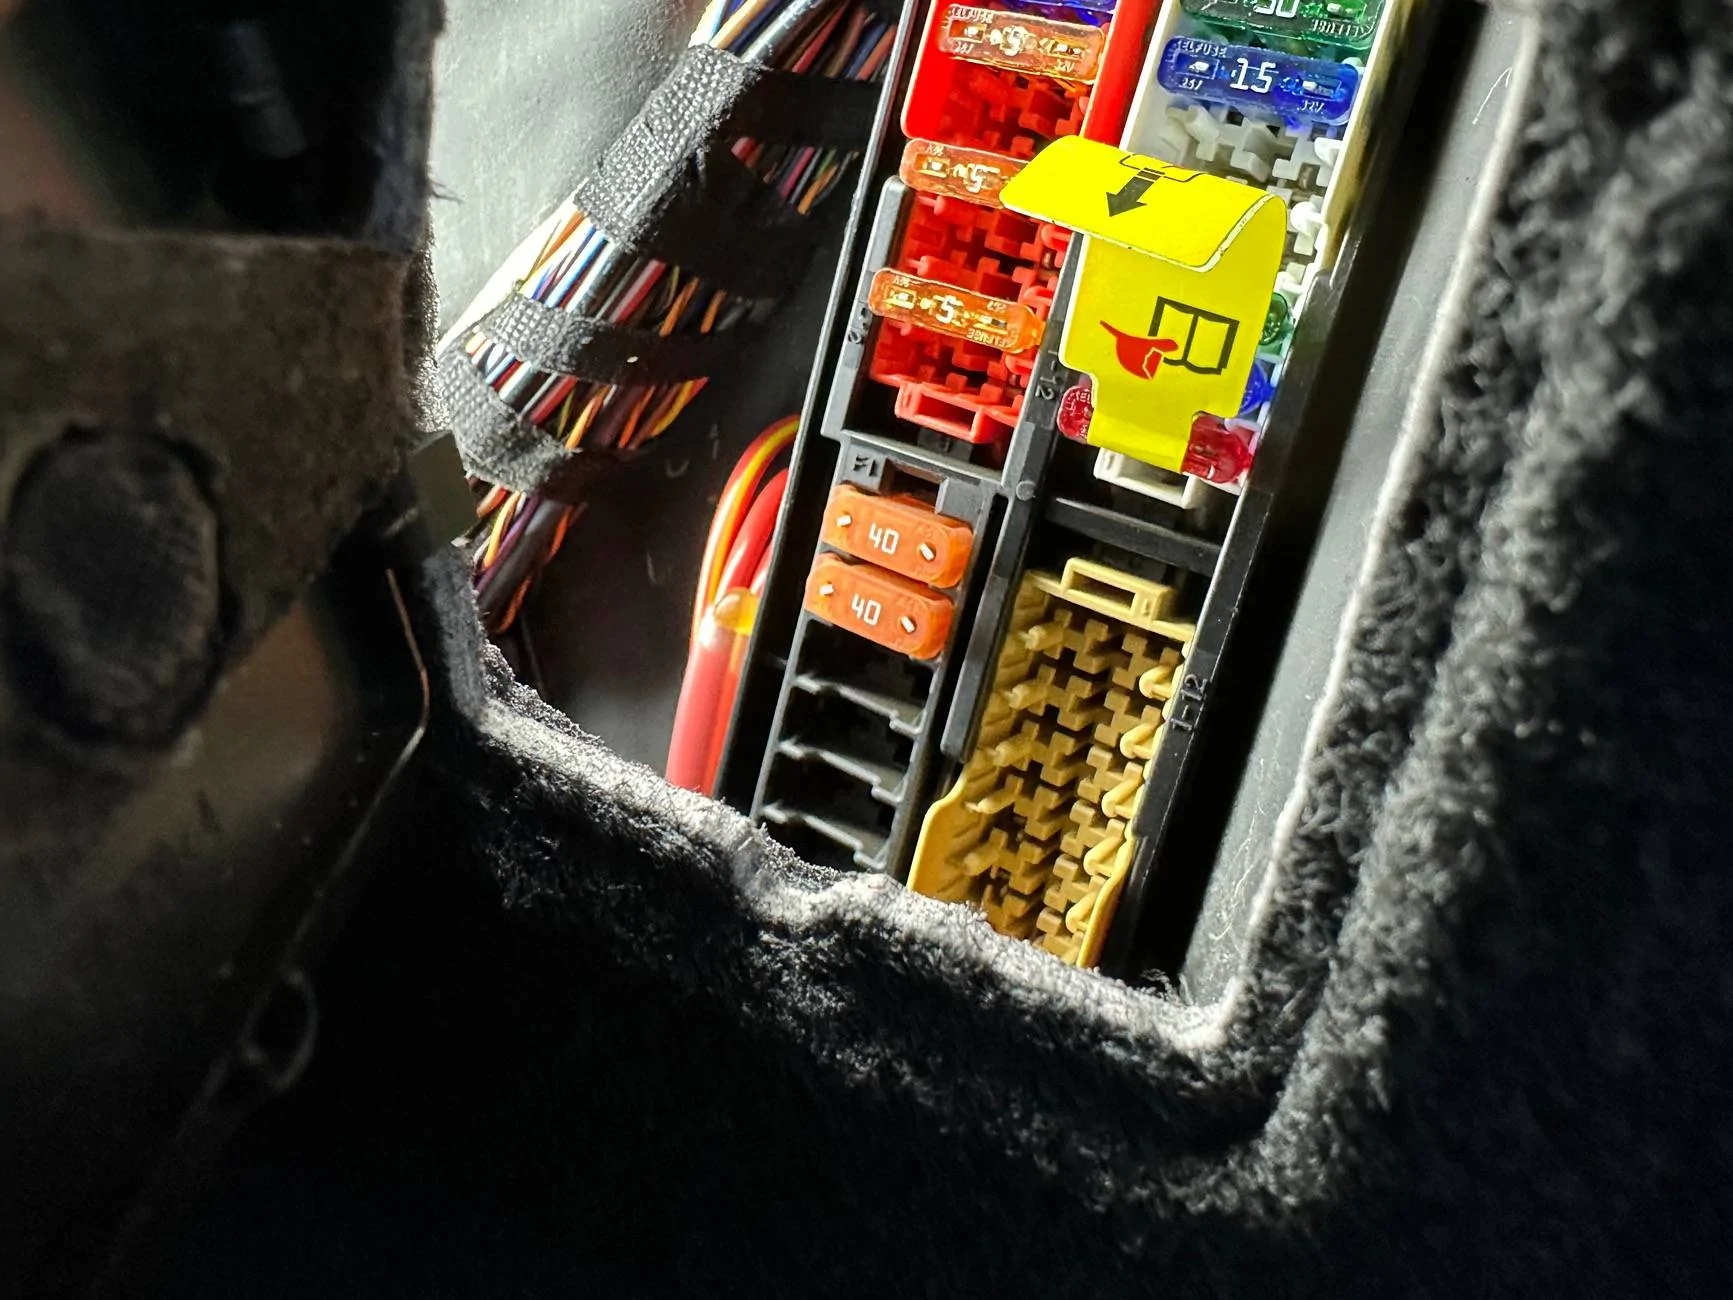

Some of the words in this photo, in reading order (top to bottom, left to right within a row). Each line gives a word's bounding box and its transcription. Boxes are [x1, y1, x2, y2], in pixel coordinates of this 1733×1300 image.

[1229, 57, 1277, 94] 15
[868, 523, 899, 555] 40
[851, 593, 881, 626] 40
[1171, 673, 1208, 731] 1-12
